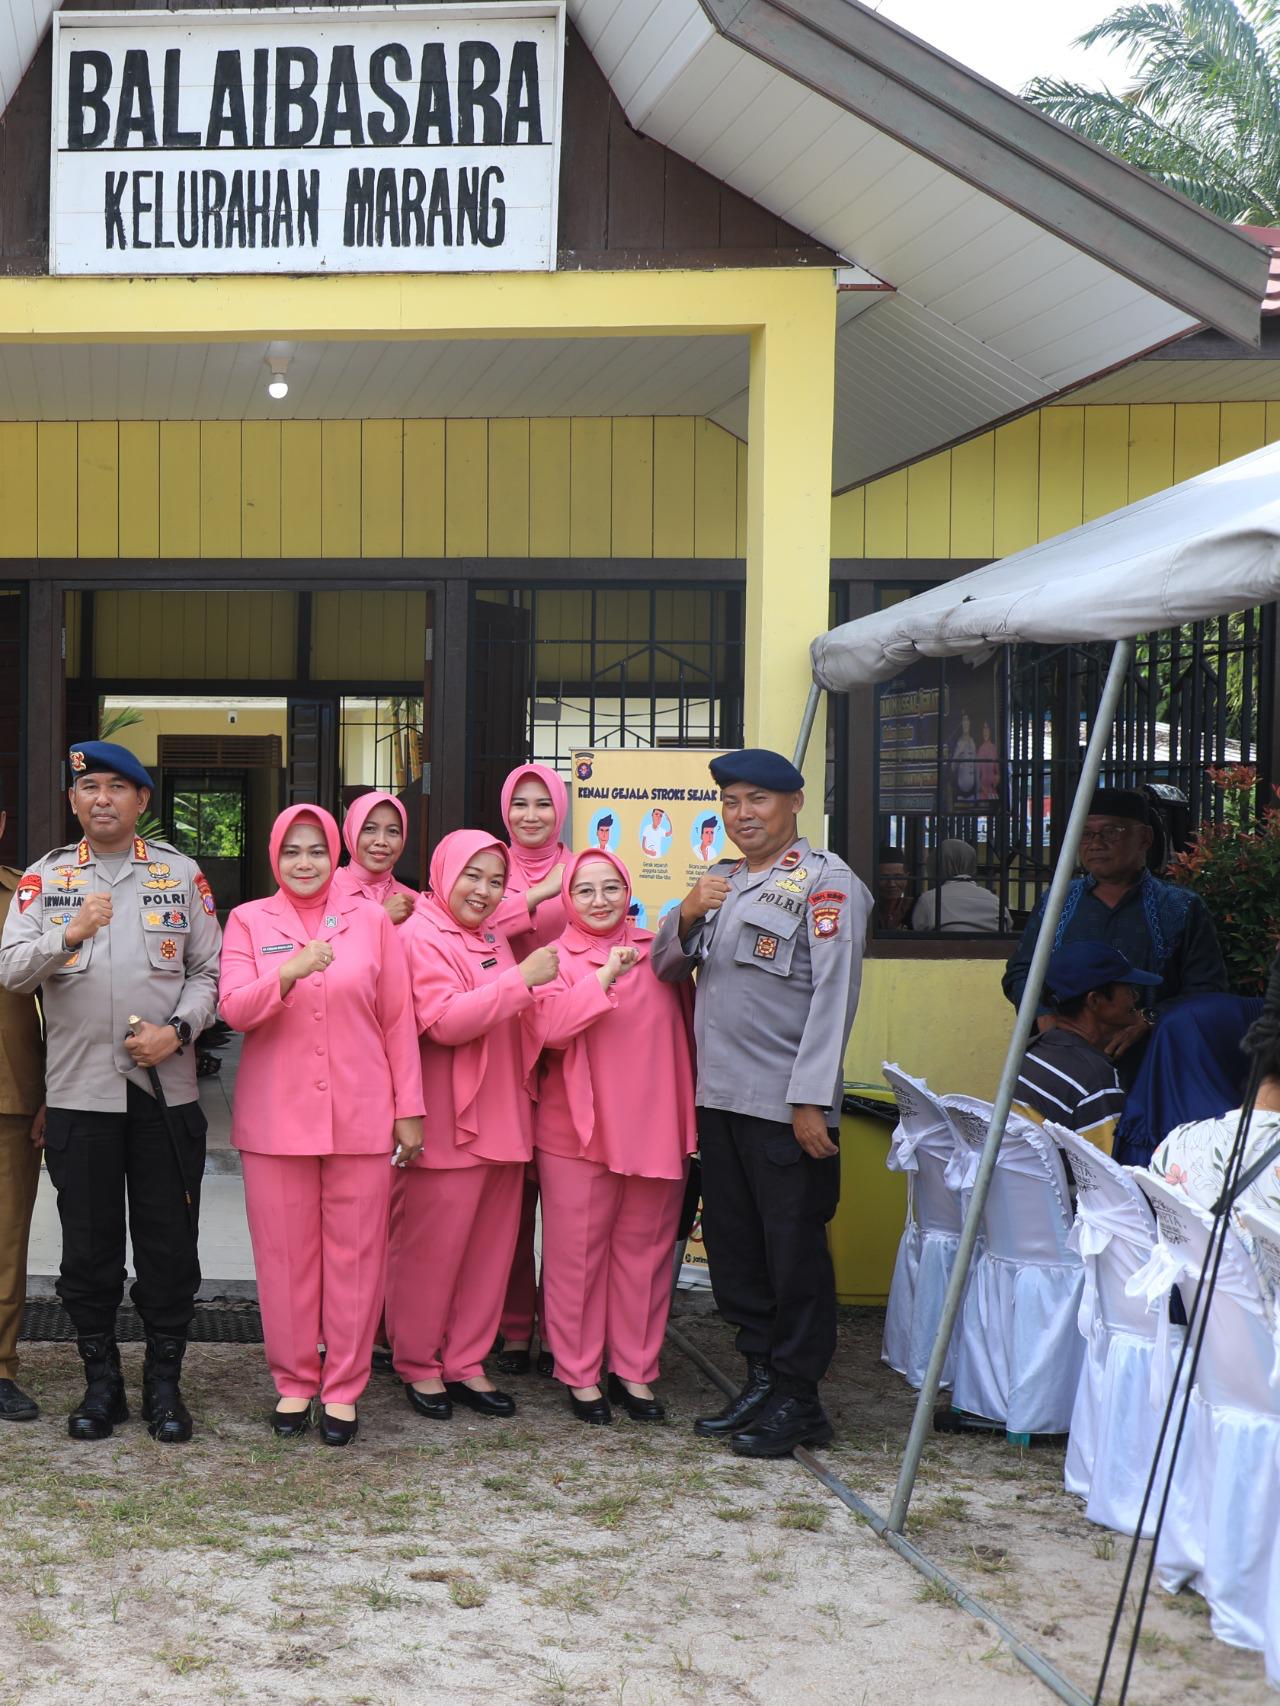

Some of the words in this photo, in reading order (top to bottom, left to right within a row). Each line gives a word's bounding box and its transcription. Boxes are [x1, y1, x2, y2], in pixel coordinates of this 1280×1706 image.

[104, 168, 319, 250] KELURAHAN
[343, 165, 505, 248] MARANG
[578, 787, 609, 799] KENALI
[611, 787, 649, 800] GEJALA
[651, 788, 686, 801] STROKE
[687, 789, 718, 802] SEJAK
[44, 895, 70, 908] IRWAN
[143, 893, 186, 906] POLRI
[757, 893, 803, 914] POLRI
